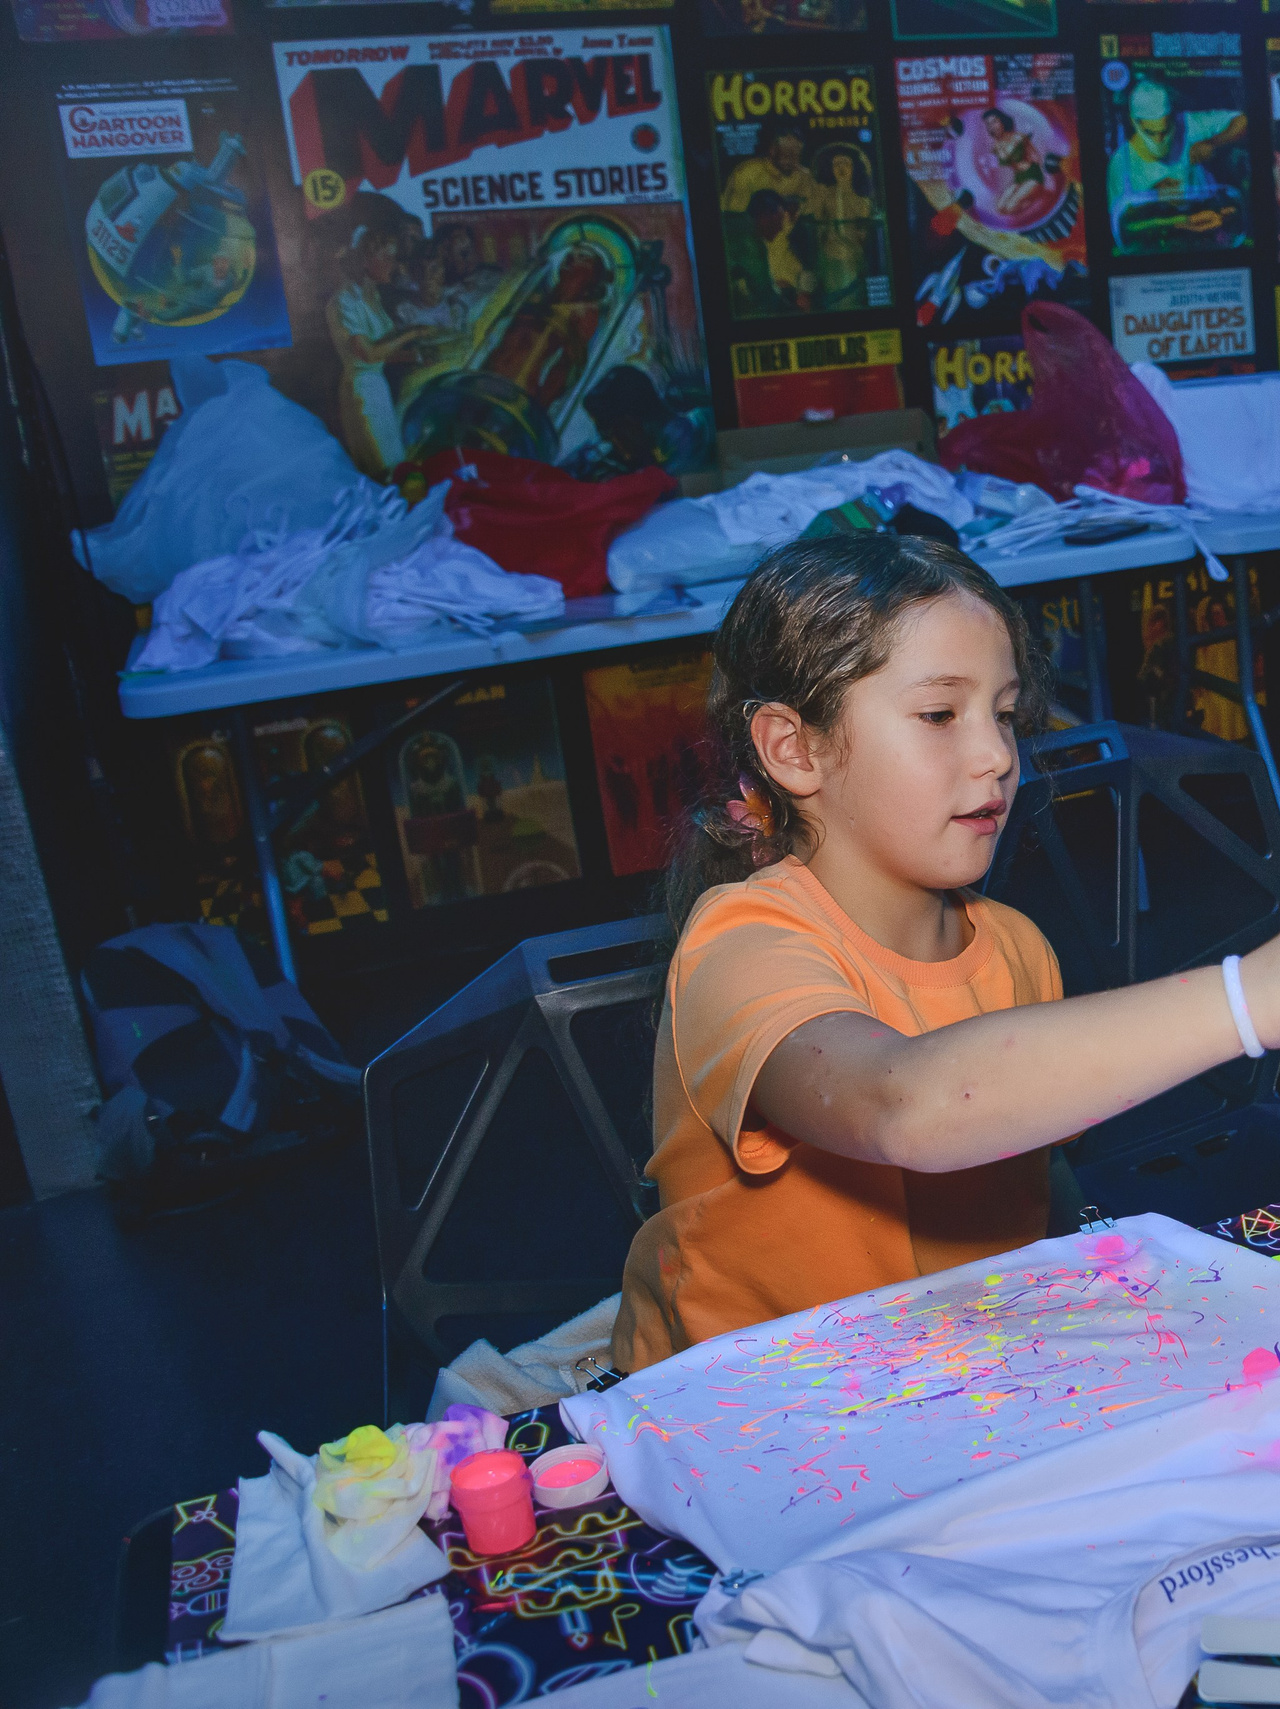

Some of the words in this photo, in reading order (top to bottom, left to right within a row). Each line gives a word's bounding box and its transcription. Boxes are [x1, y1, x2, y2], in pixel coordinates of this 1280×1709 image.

[285, 45, 410, 67] TOMORROW
[898, 56, 987, 82] COSMOS
[711, 73, 875, 122] HORROR
[69, 106, 182, 134] CARTOON
[291, 53, 662, 190] MARVEL
[71, 130, 185, 150] HANGOVER
[422, 174, 544, 209] SCIENCE
[554, 162, 668, 197] STORIES
[1124, 306, 1246, 336] DAUGHTERS
[1147, 336, 1176, 358] OF
[1180, 331, 1246, 356] EARTH
